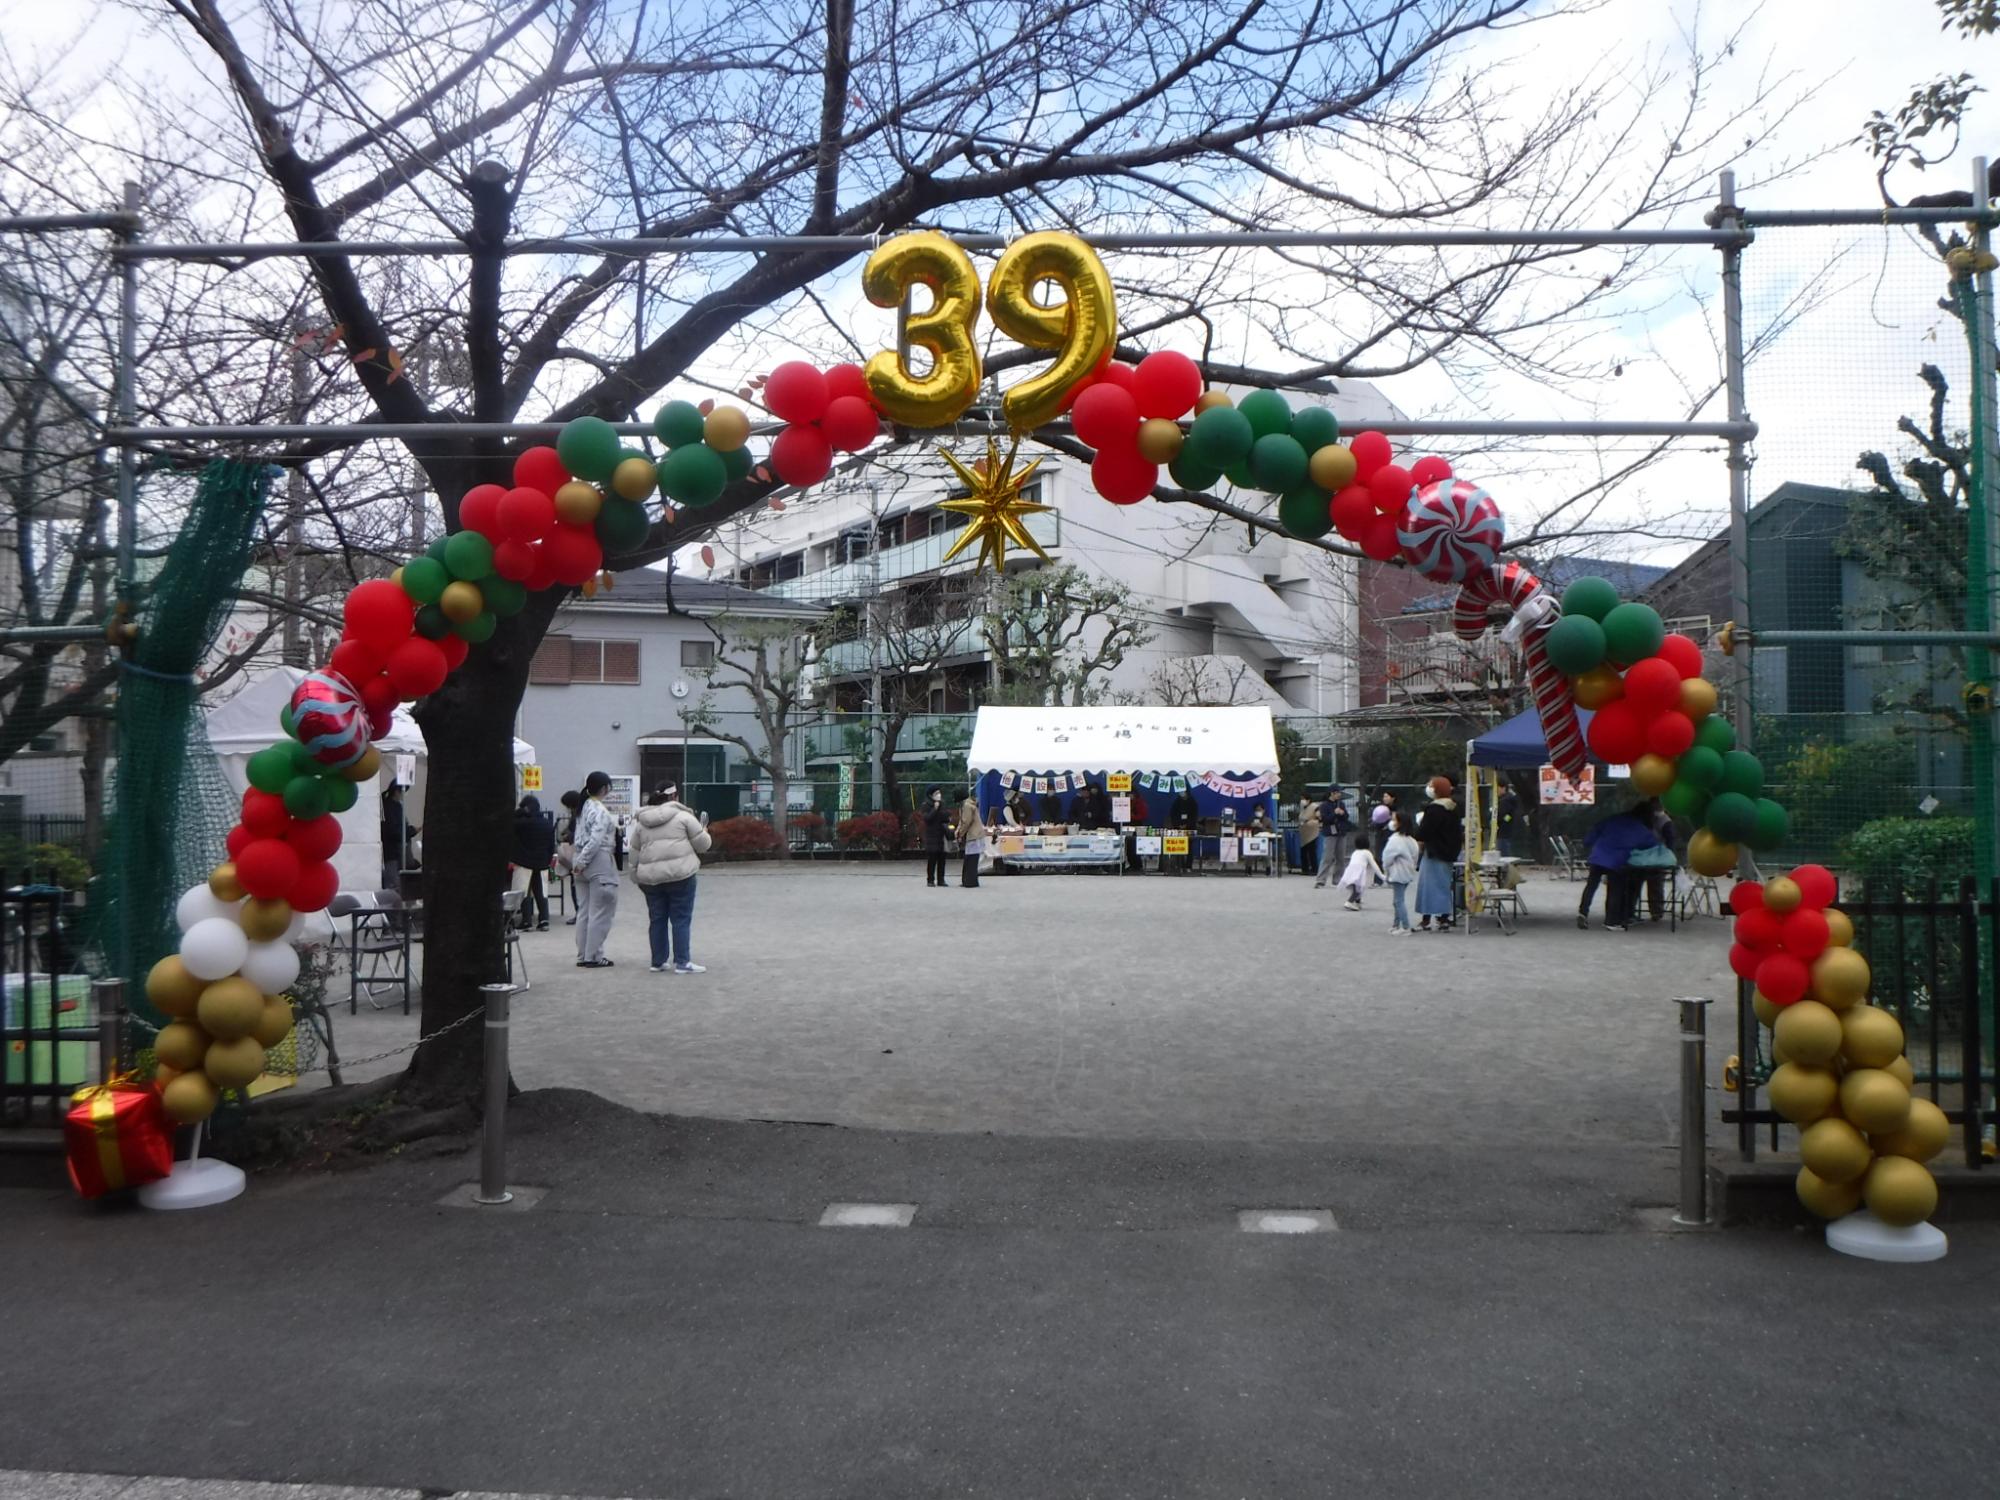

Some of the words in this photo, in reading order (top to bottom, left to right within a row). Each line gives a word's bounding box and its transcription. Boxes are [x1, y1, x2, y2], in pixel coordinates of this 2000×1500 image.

[862, 229, 1118, 436] 39
[1140, 774, 1186, 791] 飲み物
